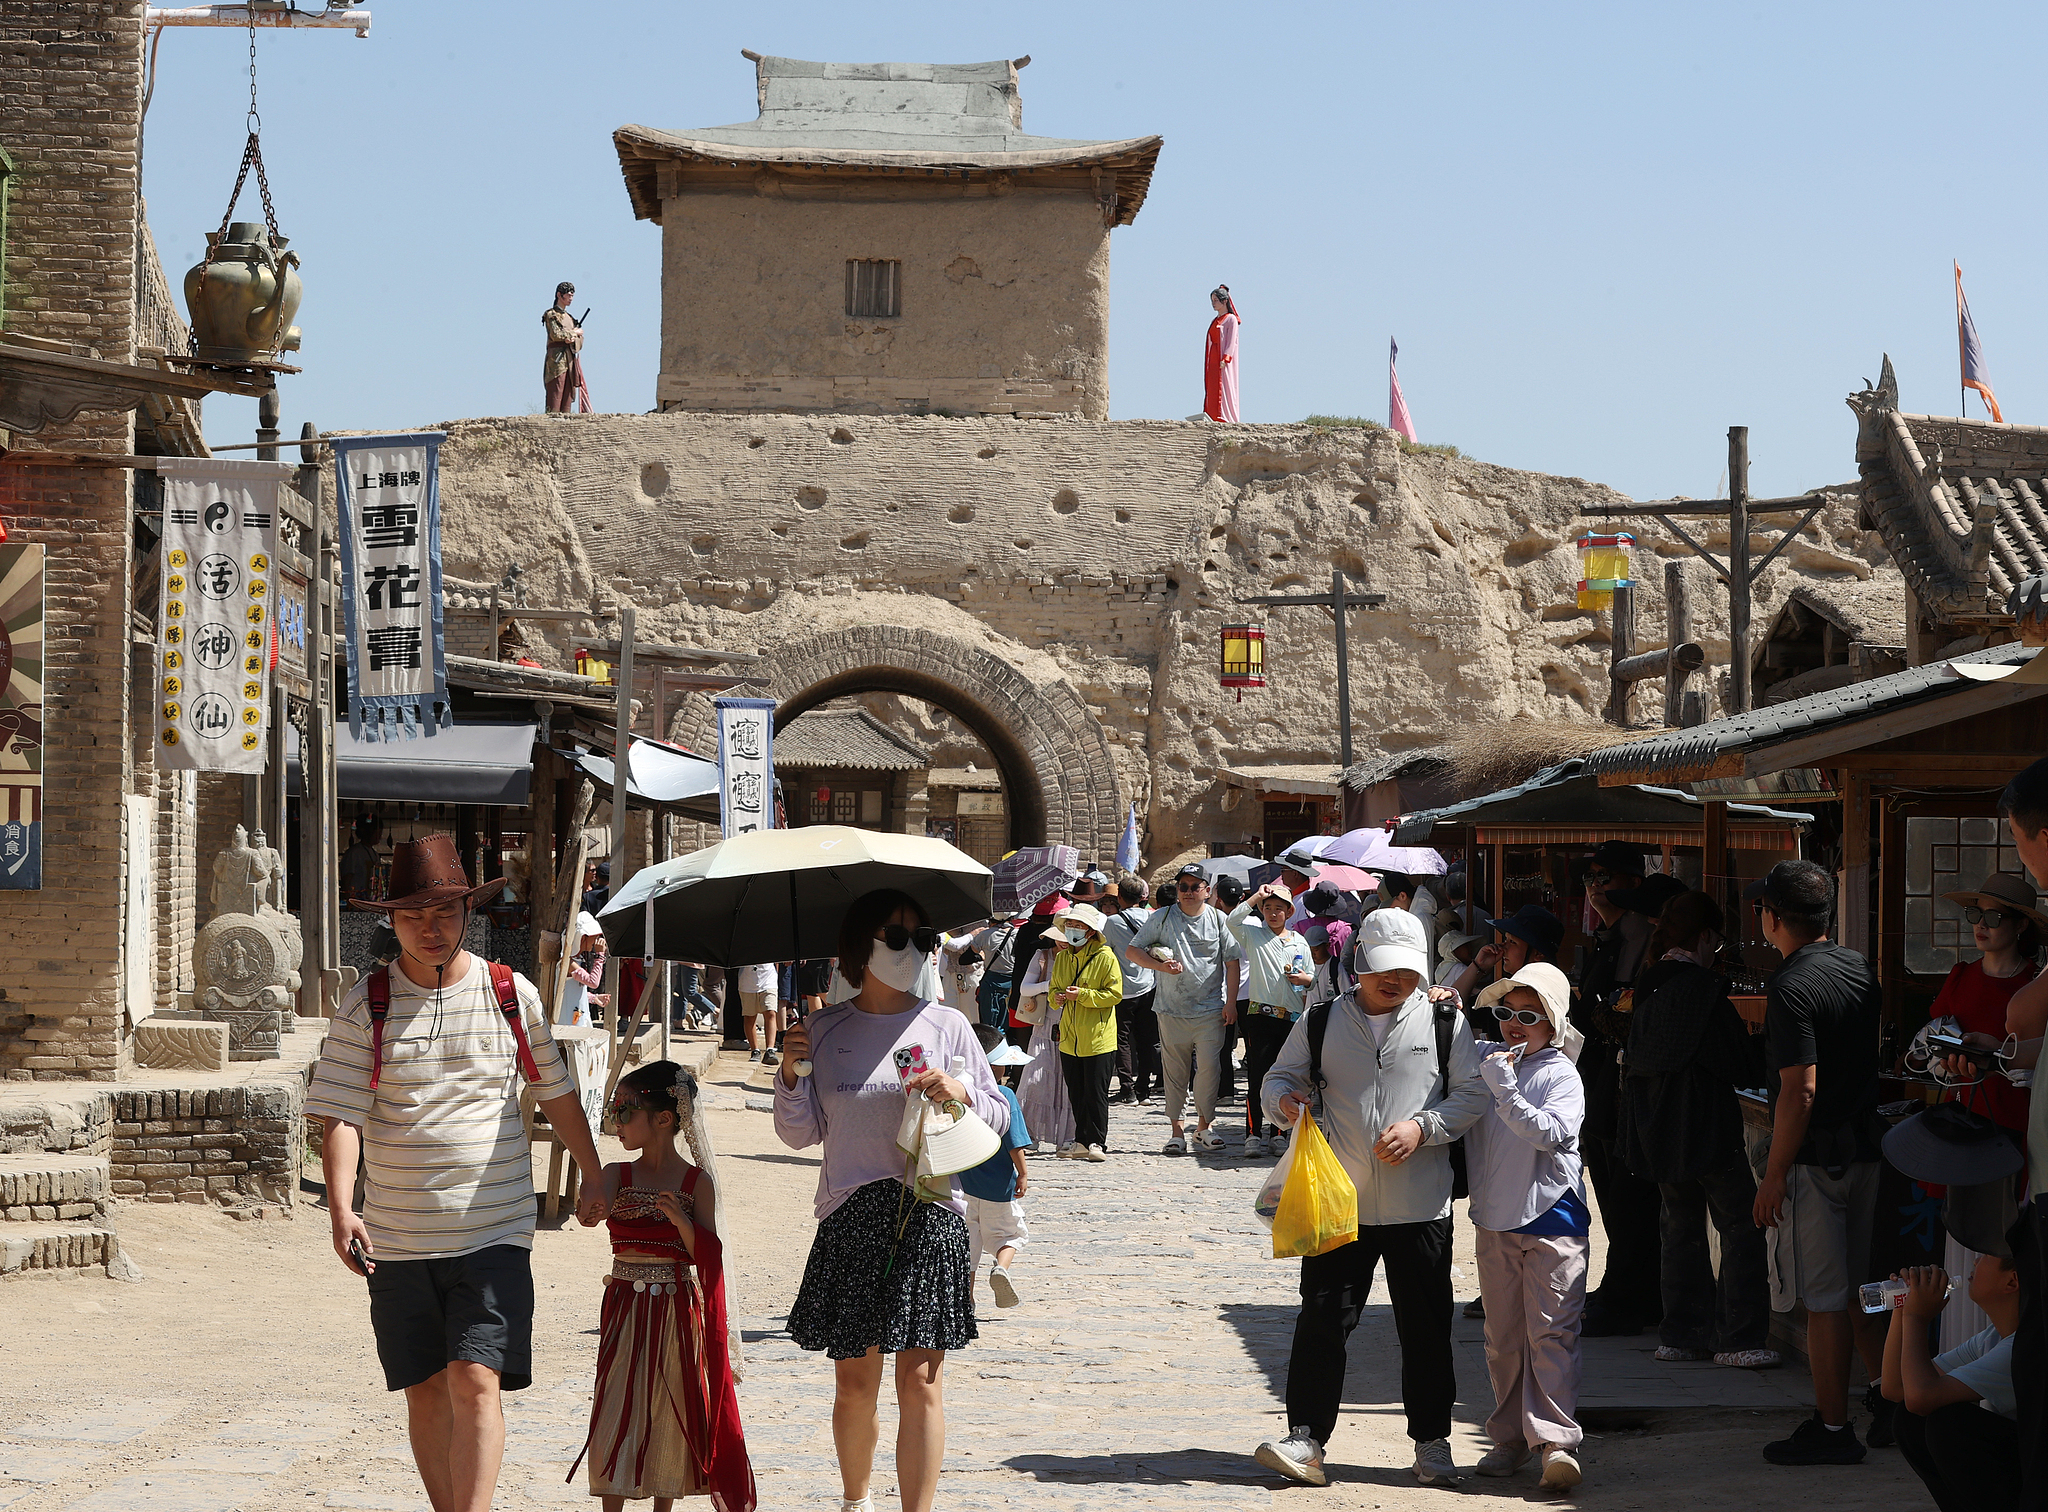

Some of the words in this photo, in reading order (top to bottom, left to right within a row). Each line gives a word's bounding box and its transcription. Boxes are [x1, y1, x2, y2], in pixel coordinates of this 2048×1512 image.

[357, 472, 421, 490] 上海牌
[195, 560, 233, 731] 活神仙
[4, 824, 21, 856] 消食
[1411, 1045, 1429, 1053] Jeep
[836, 1082, 877, 1093] dream
